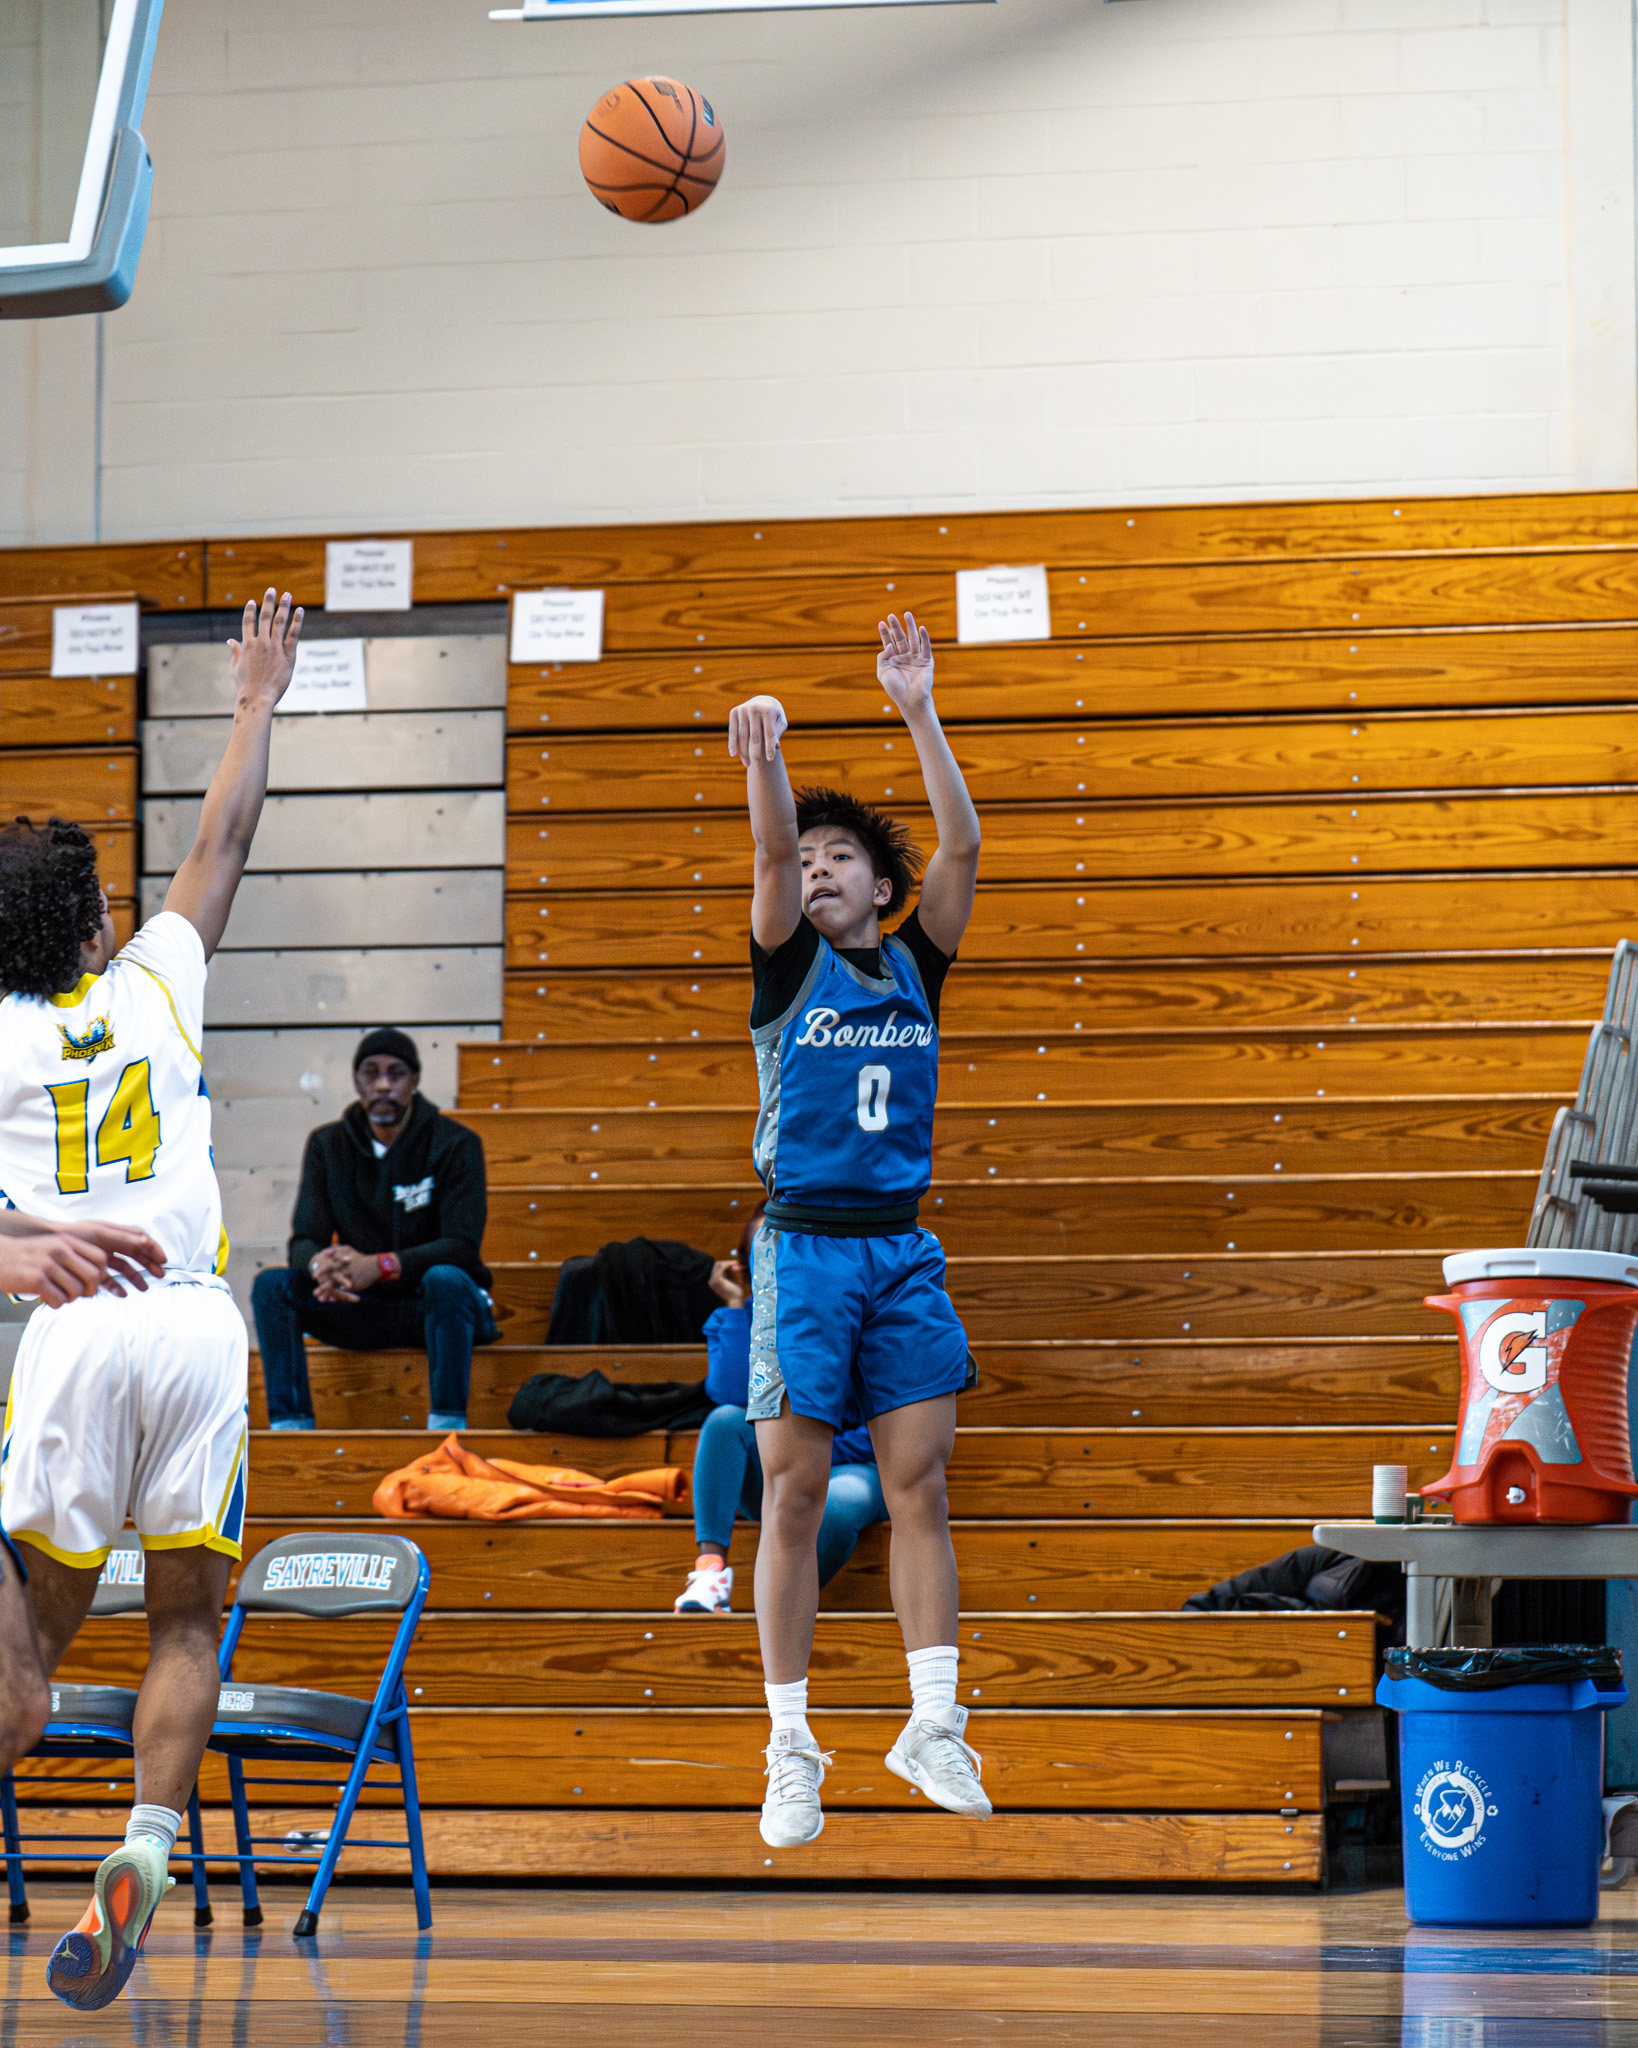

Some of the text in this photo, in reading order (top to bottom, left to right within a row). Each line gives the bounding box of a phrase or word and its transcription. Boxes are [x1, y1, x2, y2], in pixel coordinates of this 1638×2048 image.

[796, 1007, 934, 1048] Bombers
[62, 1035, 115, 1060] PHOENIX
[857, 1063, 891, 1133] 0
[43, 1056, 162, 1195] 14
[1480, 1311, 1547, 1394] G
[263, 1553, 397, 1591] SAYREVILLE
[217, 1691, 255, 1711] BERS
[1433, 1759, 1450, 1772] WE
[1460, 1834, 1486, 1858] WINS
